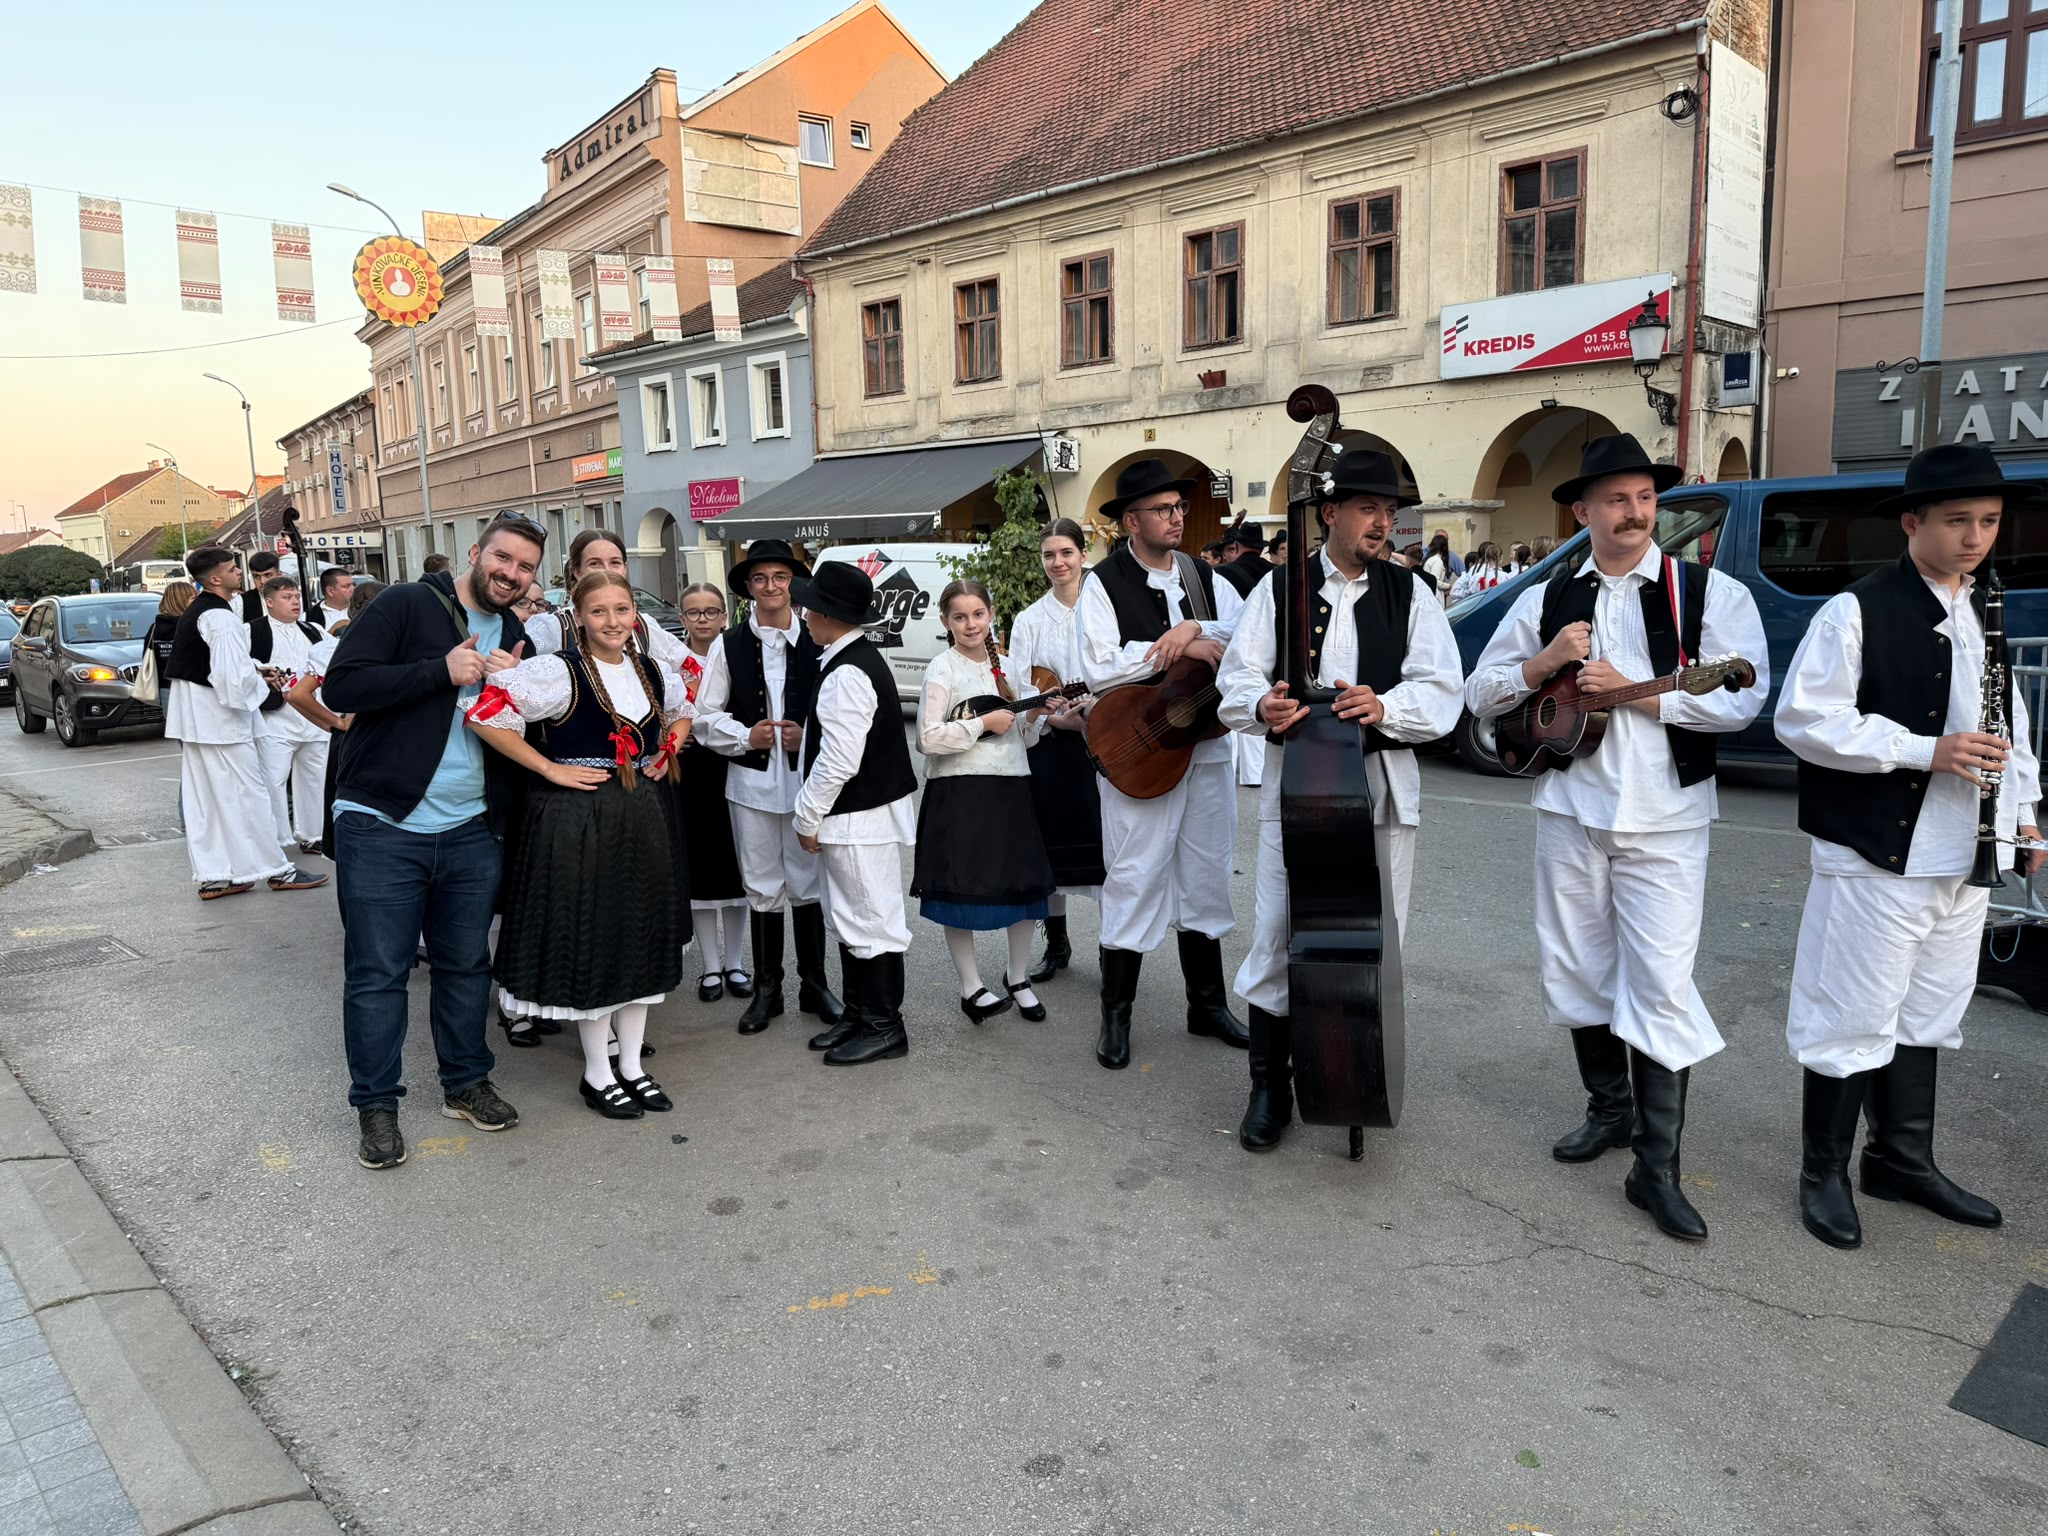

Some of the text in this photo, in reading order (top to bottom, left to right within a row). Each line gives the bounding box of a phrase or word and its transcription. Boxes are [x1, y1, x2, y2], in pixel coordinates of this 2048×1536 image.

[559, 95, 649, 182] Admiral
[371, 253, 427, 297] VINKOVAČKE JESENI
[1464, 333, 1535, 357] KREDIS
[1584, 333, 1598, 344] 01
[1601, 331, 1616, 342] 55
[579, 460, 604, 474] STUDENAC
[329, 452, 344, 509] HOTEL
[690, 484, 738, 505] Nikolina
[794, 522, 829, 537] JANUŠ
[304, 535, 366, 546] HOTEL
